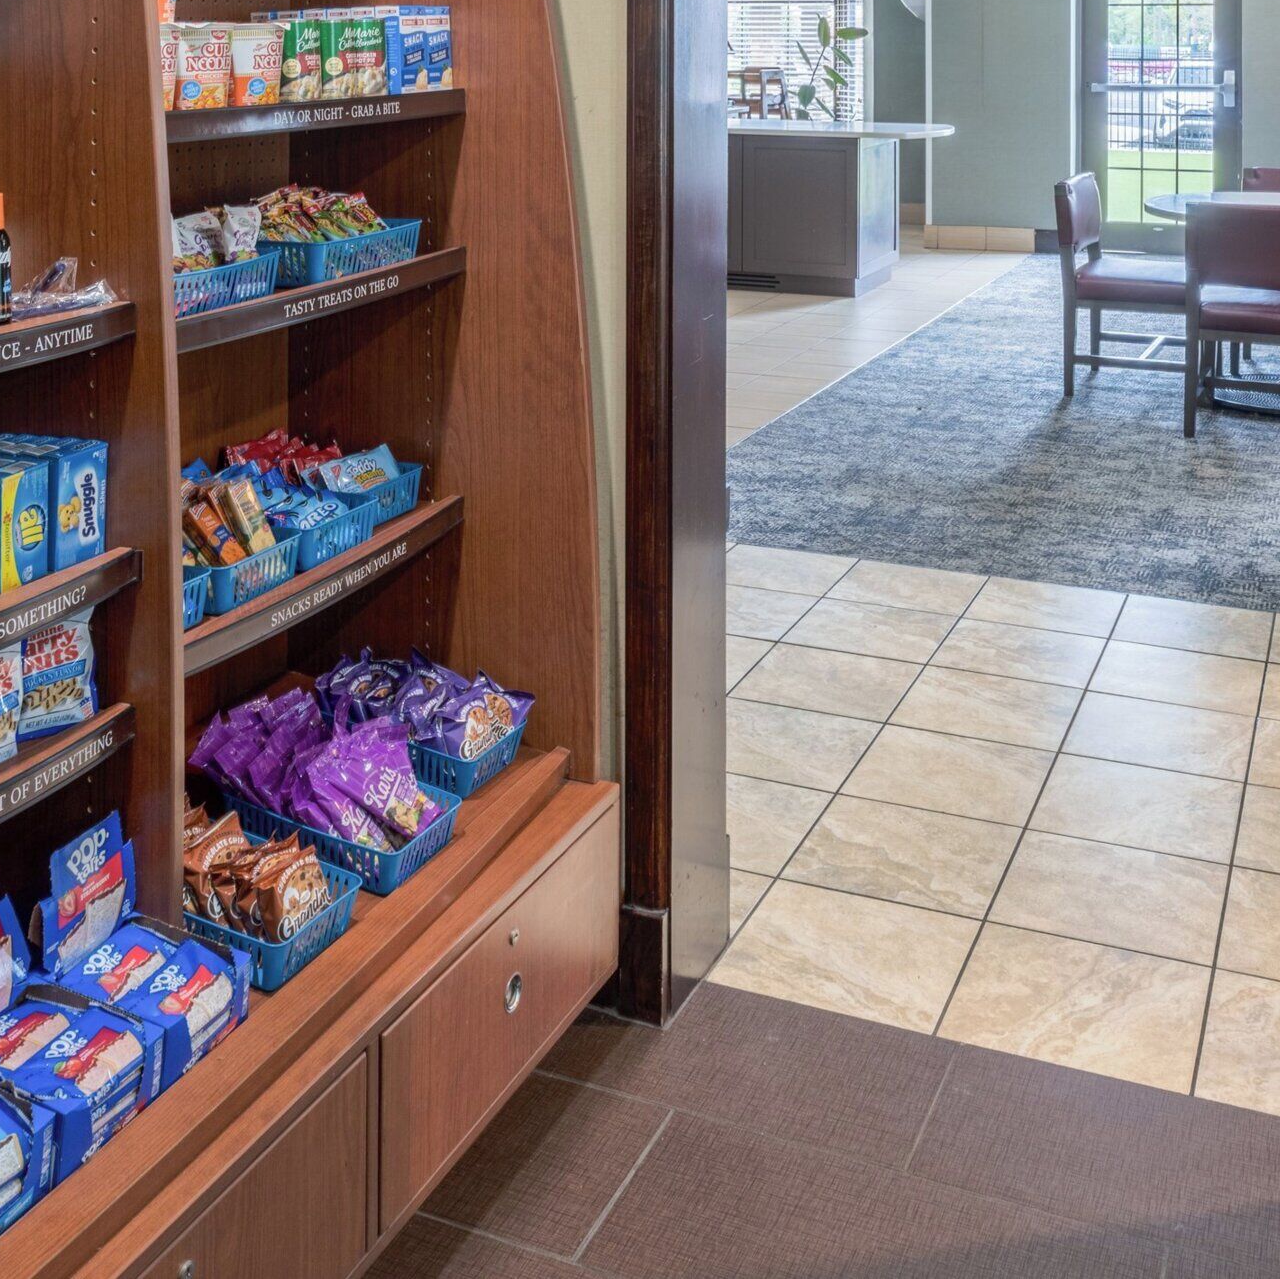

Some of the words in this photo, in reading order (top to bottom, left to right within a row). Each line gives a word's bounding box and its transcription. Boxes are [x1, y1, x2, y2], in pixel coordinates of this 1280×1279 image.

[273, 109, 295, 125] DAY
[297, 109, 311, 123] OR
[313, 106, 344, 122] NIGHT
[351, 104, 374, 118] GRAB
[375, 103, 383, 116] A
[383, 101, 401, 116] BITE
[284, 299, 315, 319] TASTY
[318, 289, 353, 310] TREATS
[354, 285, 368, 301] ON
[369, 281, 386, 297] THE
[387, 275, 399, 290] GO
[34, 323, 94, 354] ANYTIME
[346, 459, 377, 478] Teddy
[81, 473, 96, 538] Snuggle
[271, 597, 312, 627] SNACKS
[313, 580, 344, 607] READY
[345, 563, 372, 589] WHEN
[373, 554, 391, 572] YOU
[392, 542, 407, 561] ARE
[10, 783, 32, 805] OF
[34, 730, 114, 791] EVERYTHING
[76, 849, 106, 884] tarts
